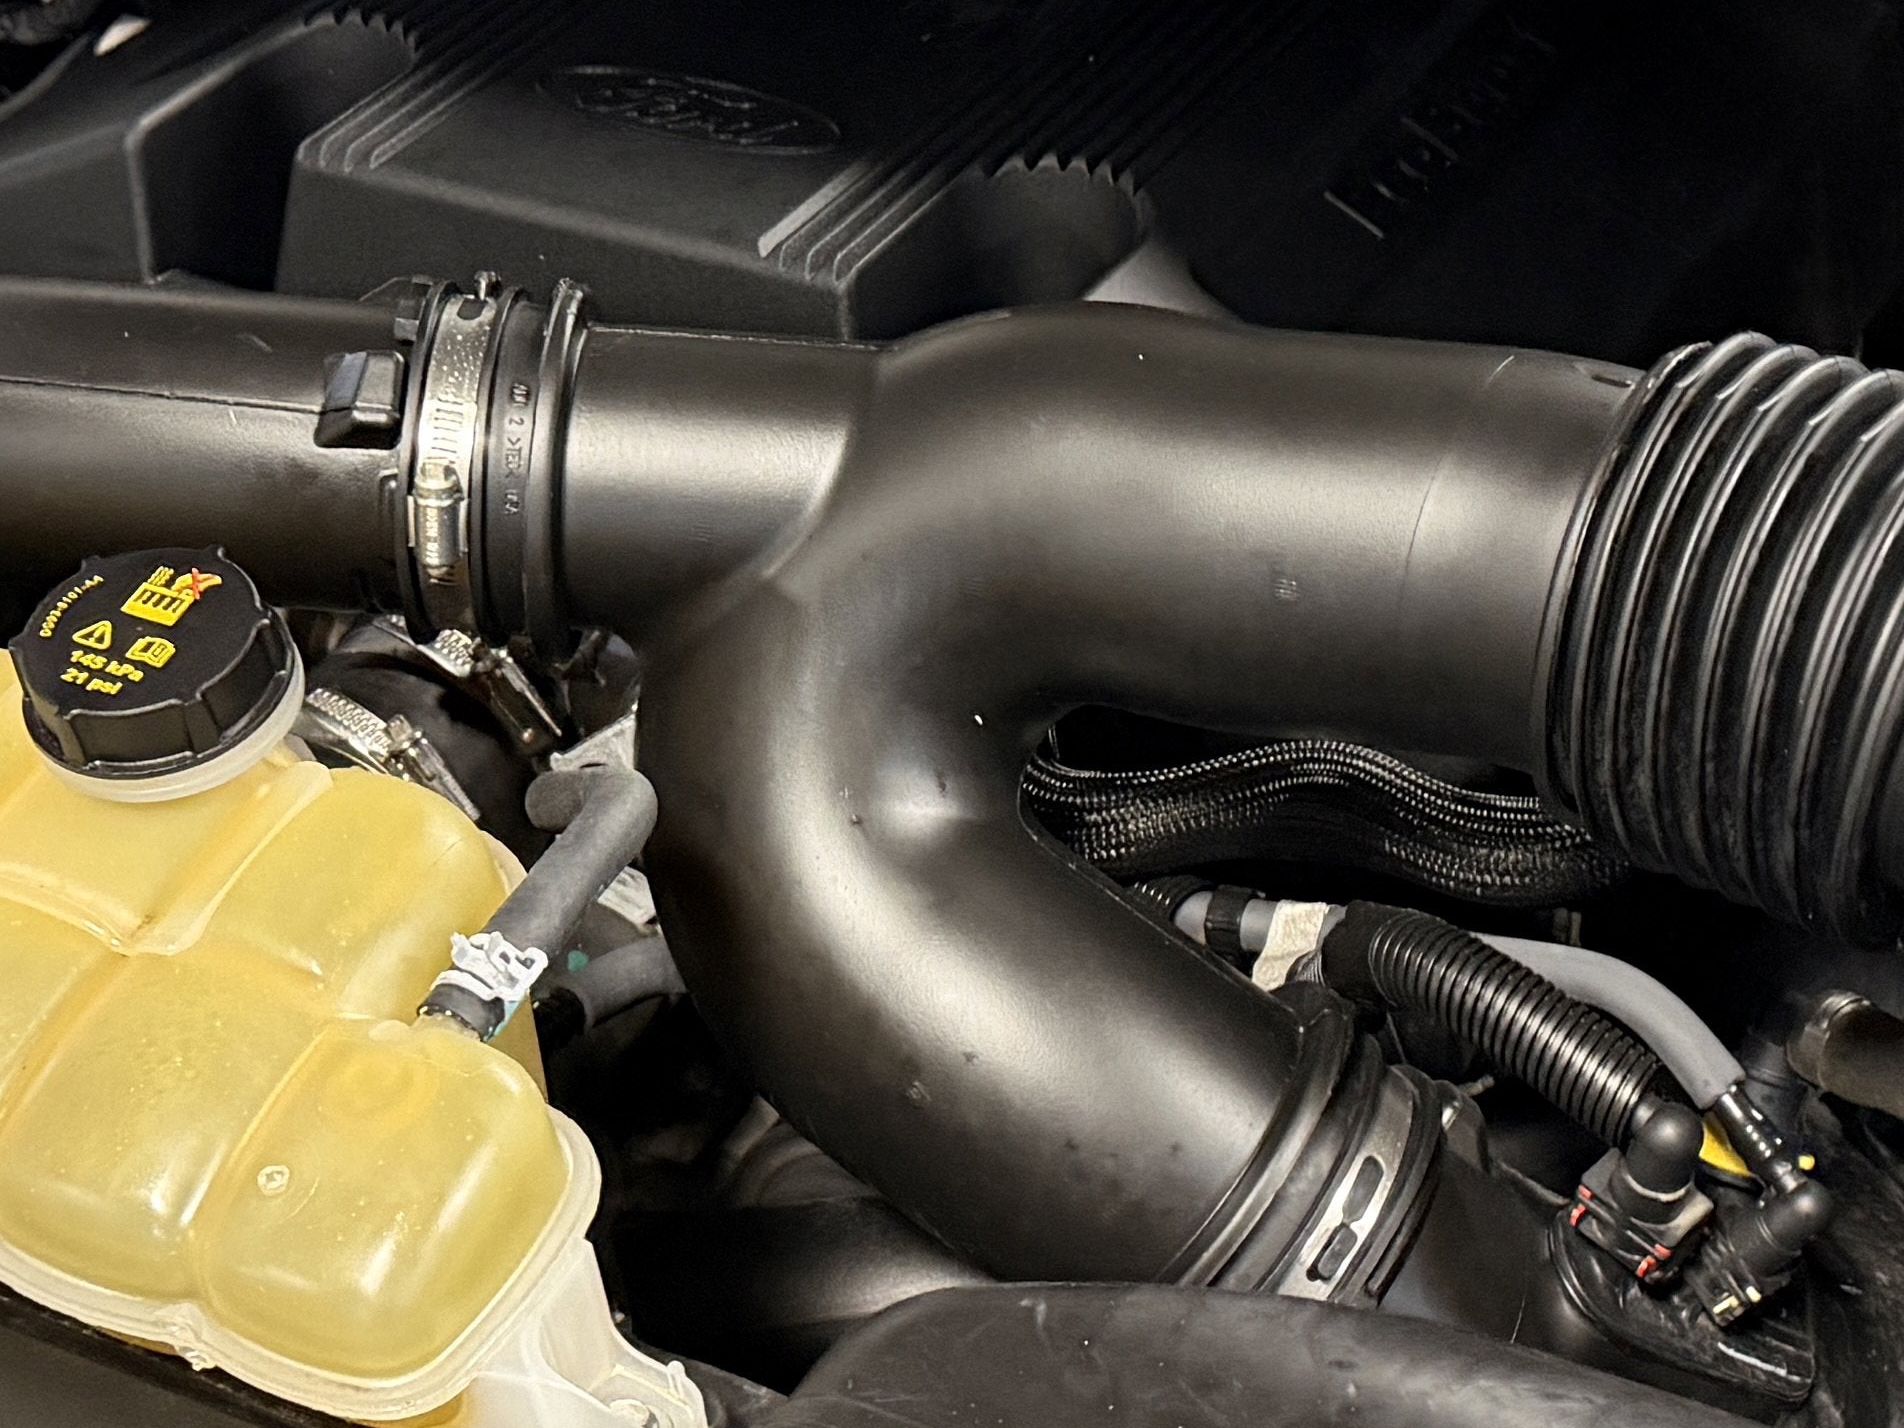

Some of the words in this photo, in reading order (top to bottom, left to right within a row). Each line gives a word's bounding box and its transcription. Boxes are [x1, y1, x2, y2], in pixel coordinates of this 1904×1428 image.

[60, 667, 89, 684] 21
[85, 678, 123, 694] psi
[70, 650, 108, 669] 145
[105, 660, 145, 682] kPa
